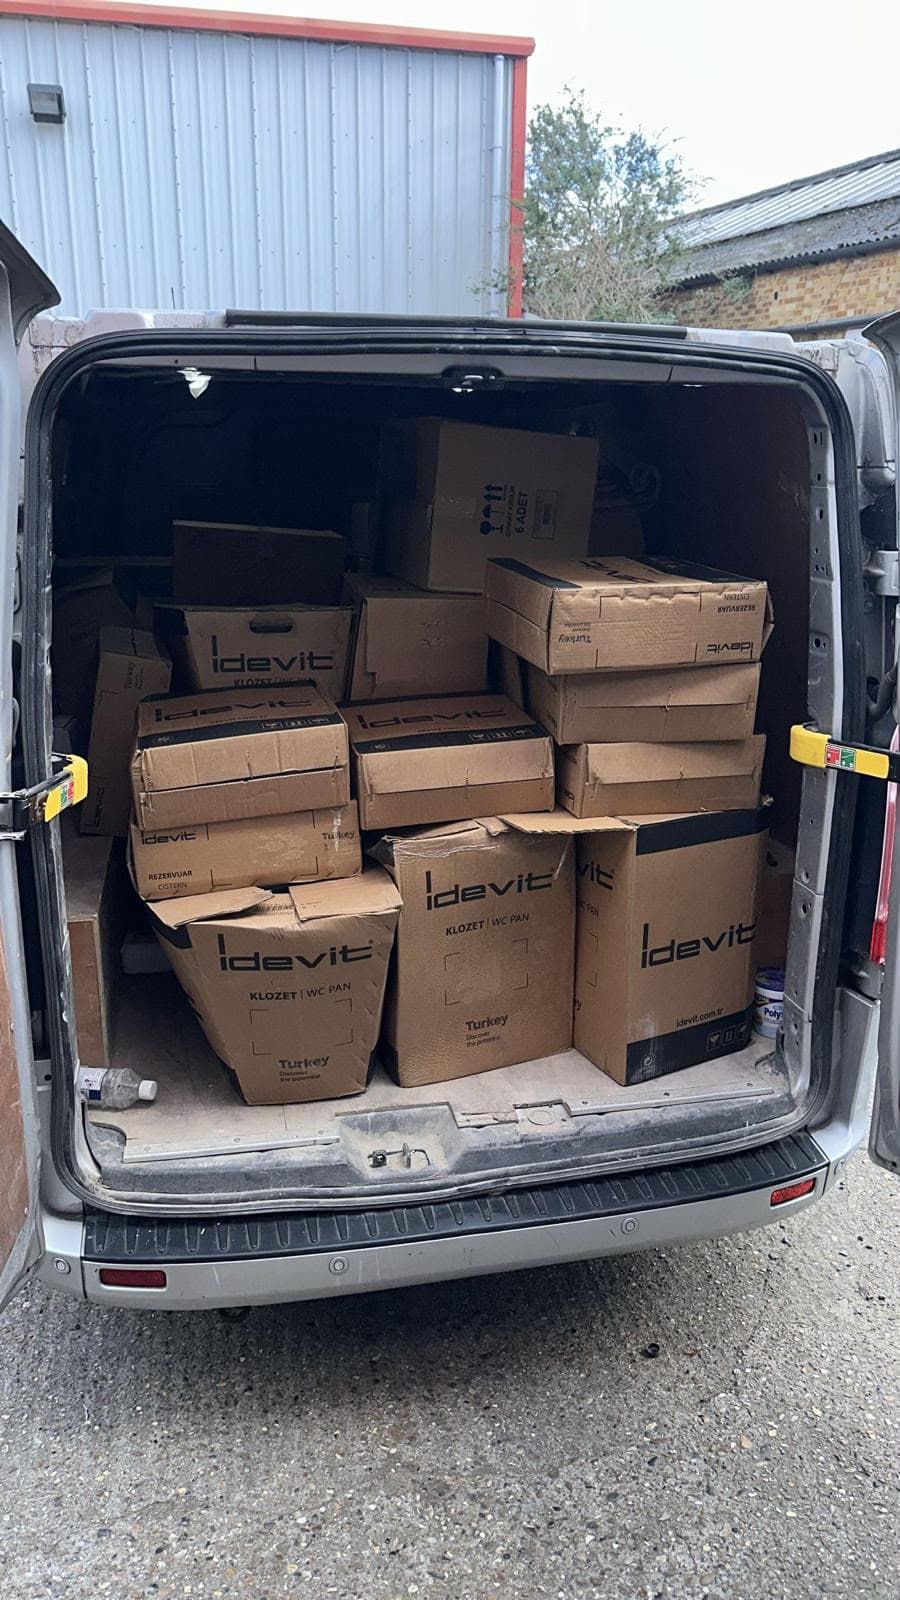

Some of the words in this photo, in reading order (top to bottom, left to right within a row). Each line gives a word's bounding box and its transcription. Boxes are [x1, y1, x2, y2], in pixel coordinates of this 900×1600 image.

[717, 604, 756, 613] REZERVUAR
[558, 634, 592, 644] Turkey
[322, 831, 355, 840] Tukey
[148, 870, 193, 881] REZERVUAR
[158, 881, 187, 891] CISTERN
[445, 919, 484, 936] KLOZET
[491, 916, 508, 926] WC
[510, 912, 530, 924] PAN
[249, 989, 298, 1001] KLOZET
[306, 988, 326, 997] WC
[328, 981, 352, 993] PAN
[763, 1006, 784, 1020] Poly
[465, 1014, 509, 1031] Turkey
[278, 1055, 330, 1069] Turkey
